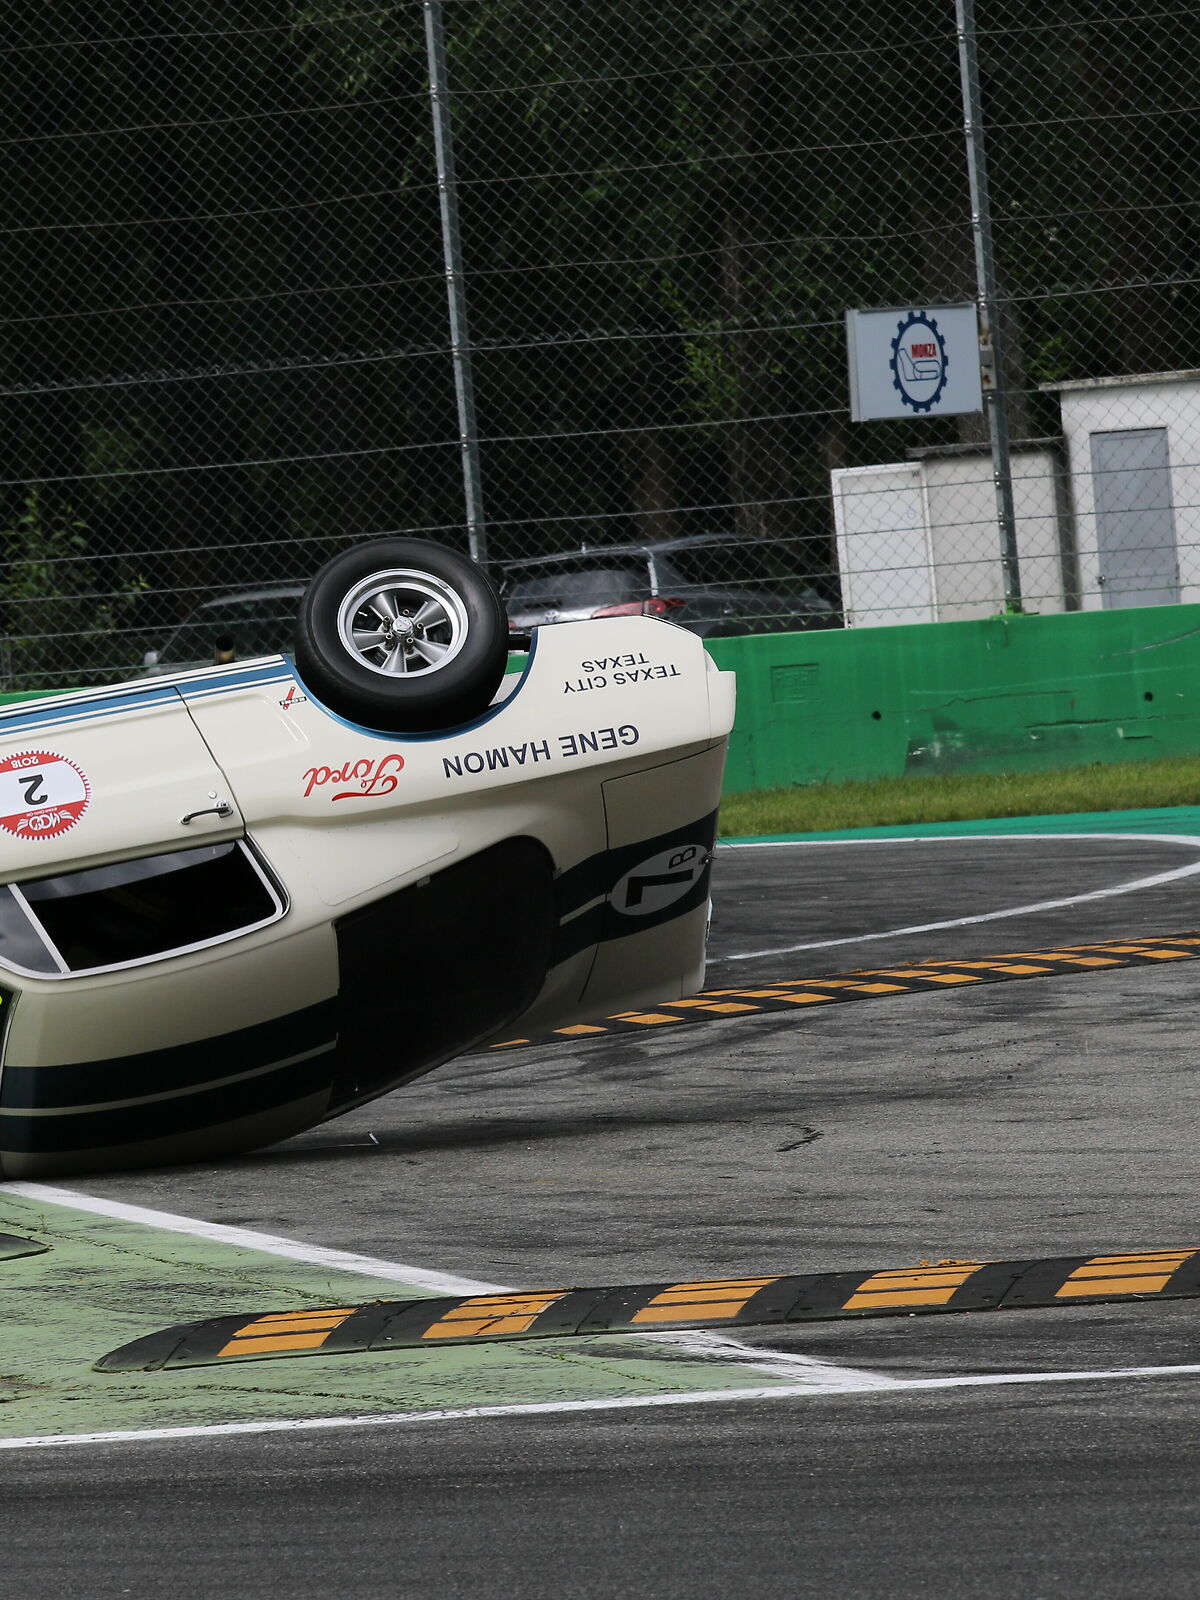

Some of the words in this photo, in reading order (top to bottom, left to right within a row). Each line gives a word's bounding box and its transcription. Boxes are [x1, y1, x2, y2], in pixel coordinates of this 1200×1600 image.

[911, 343, 937, 358] MONZA
[580, 651, 650, 674] TEXAS
[560, 673, 608, 695] CITY
[610, 663, 682, 687] TEXAS
[557, 723, 640, 759] GENE
[10, 755, 39, 769] 2018
[440, 738, 552, 779] HAMON
[18, 774, 48, 806] 2
[302, 753, 405, 803] Ford
